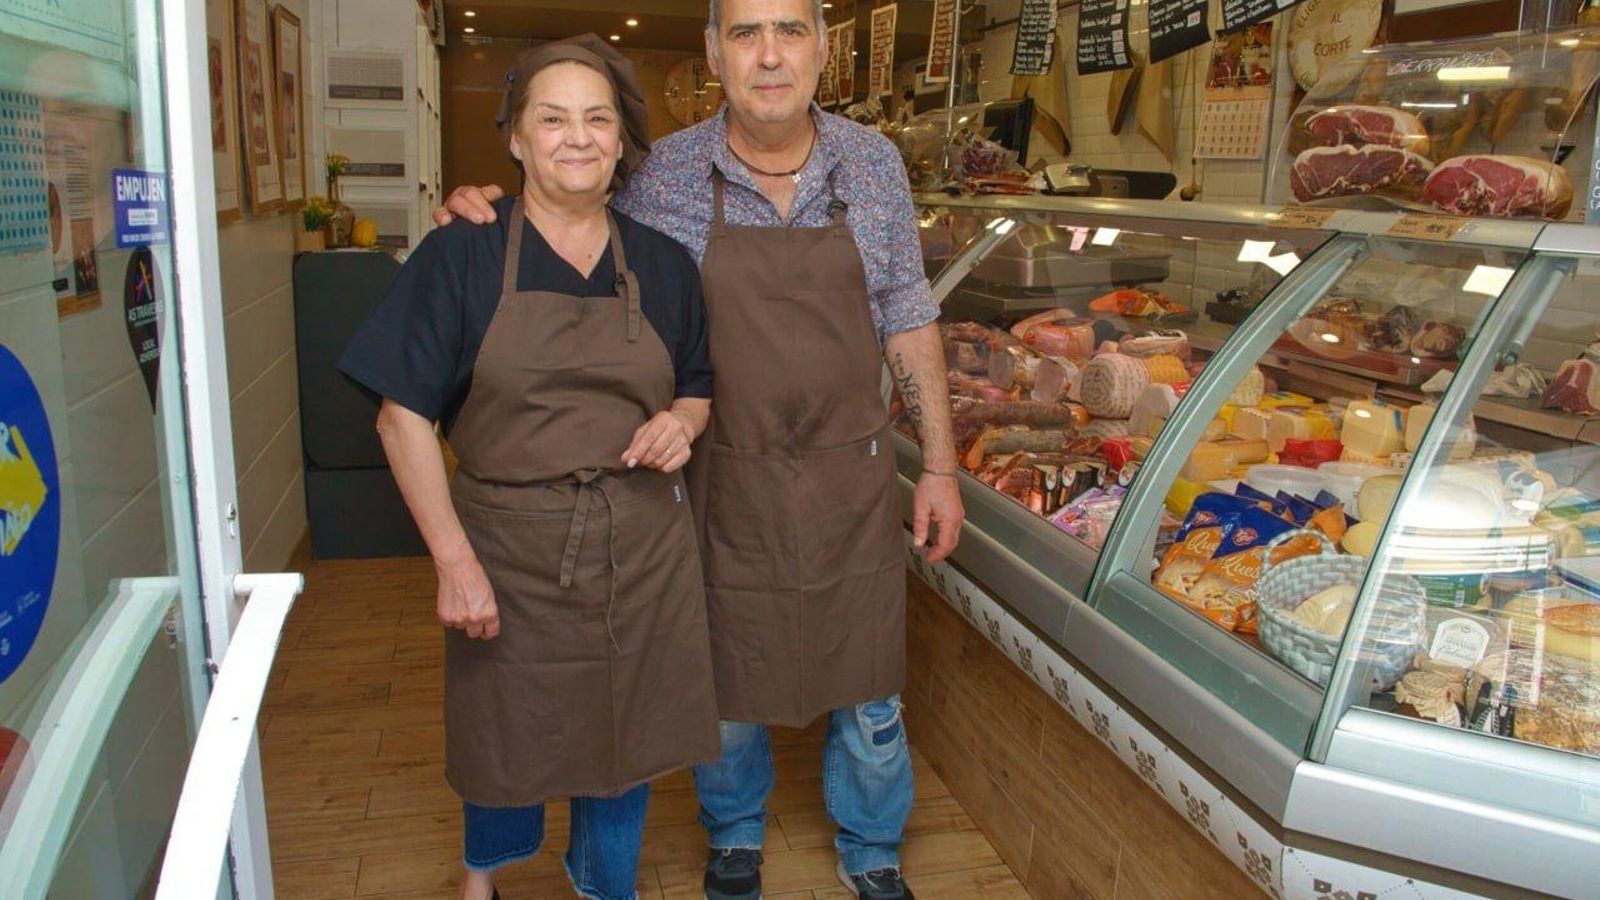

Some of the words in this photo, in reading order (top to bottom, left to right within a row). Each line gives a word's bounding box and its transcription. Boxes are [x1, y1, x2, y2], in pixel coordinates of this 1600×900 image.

[1330, 13, 1342, 24] AL
[1314, 36, 1352, 57] CORTE
[116, 175, 165, 202] EMPUJEN
